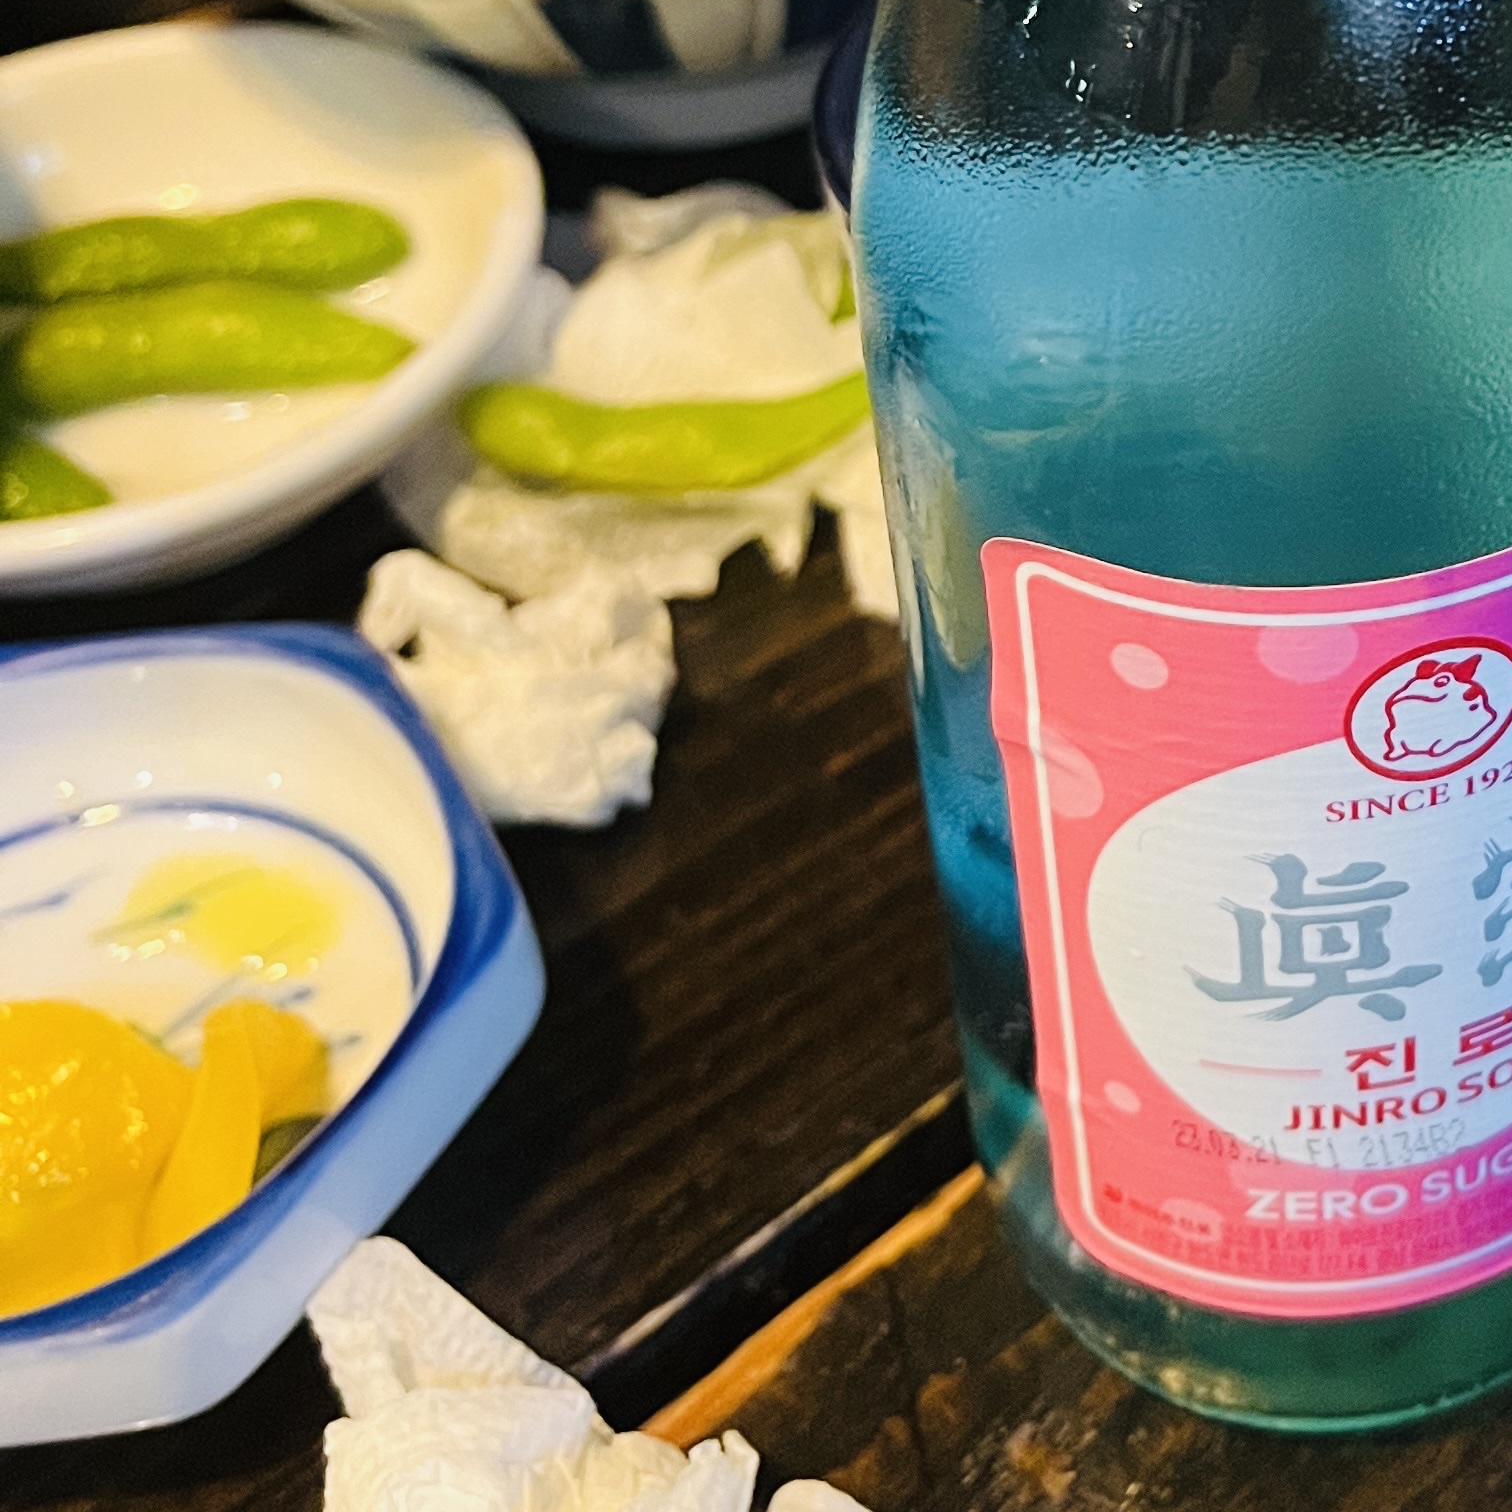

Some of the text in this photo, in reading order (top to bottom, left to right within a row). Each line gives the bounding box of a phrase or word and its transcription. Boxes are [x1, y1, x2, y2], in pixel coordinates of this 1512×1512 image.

[1325, 782, 1451, 823] SINCE
[1283, 1086, 1447, 1131] JINRO
[1244, 1182, 1409, 1223] ZERO
